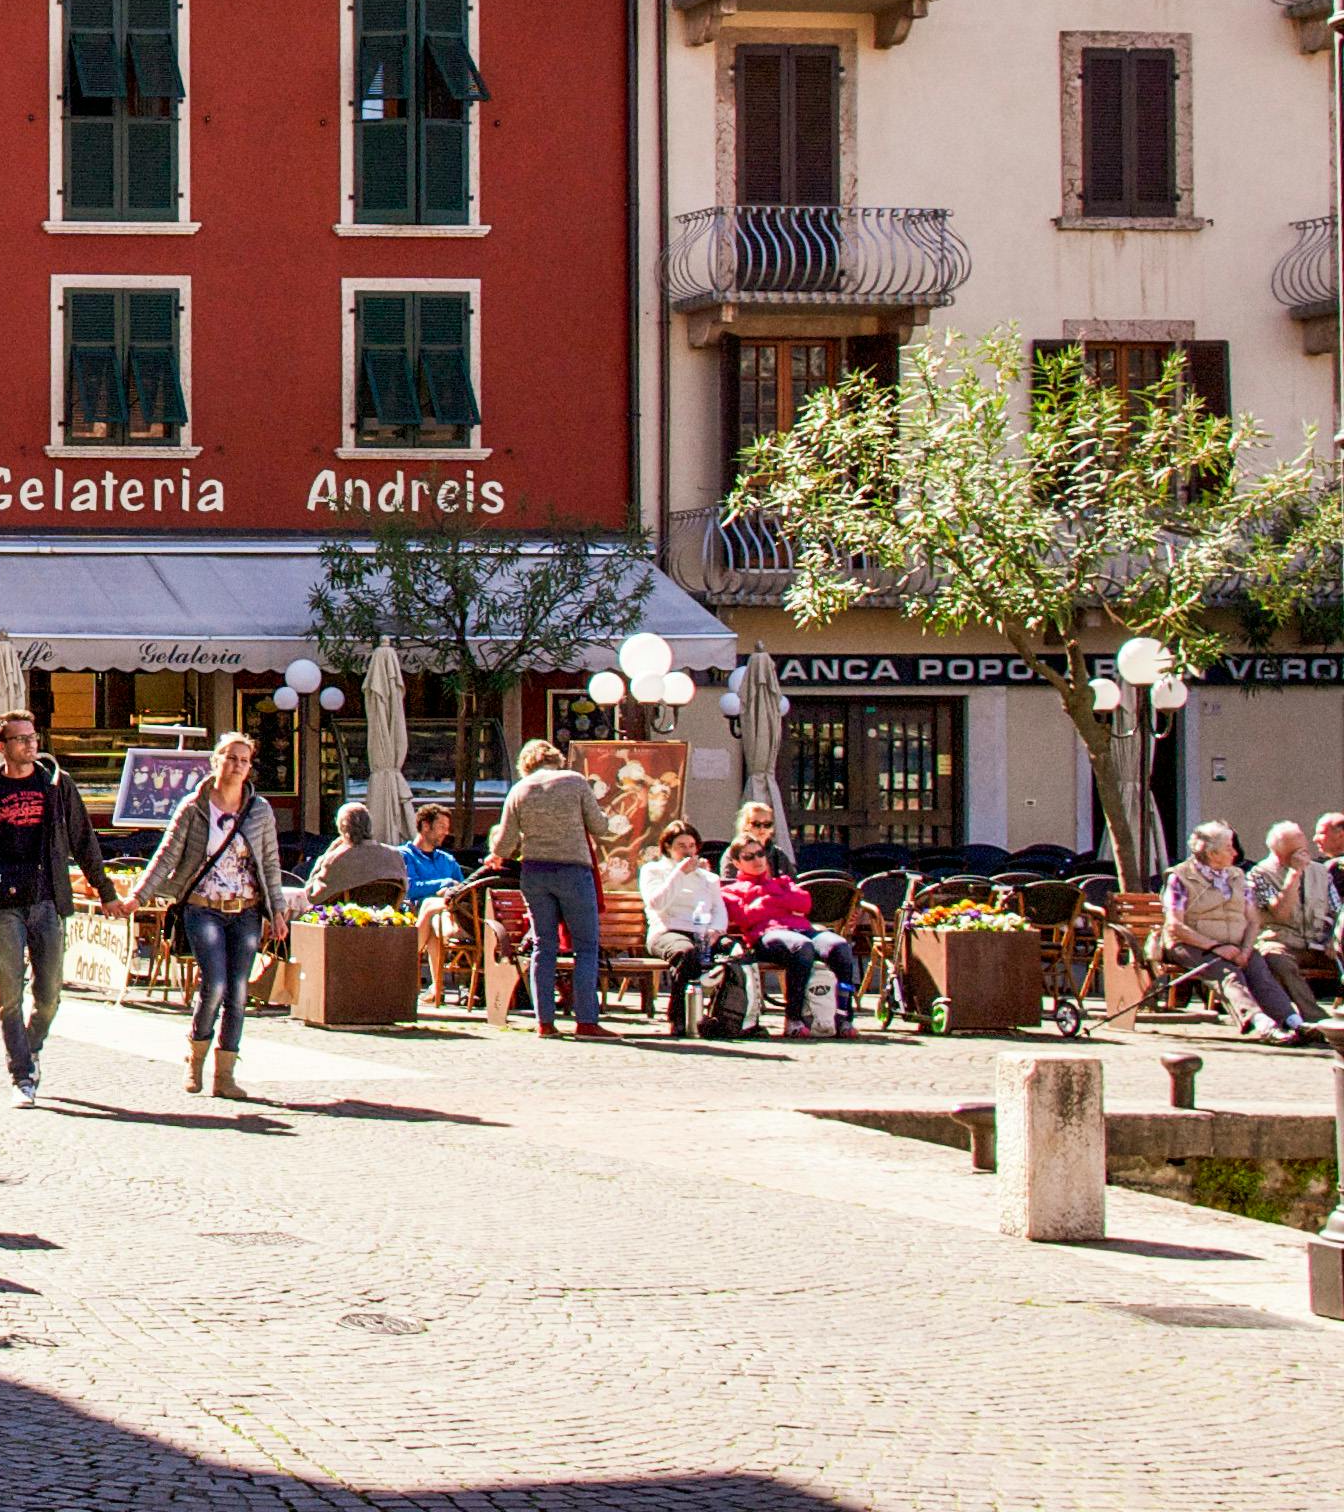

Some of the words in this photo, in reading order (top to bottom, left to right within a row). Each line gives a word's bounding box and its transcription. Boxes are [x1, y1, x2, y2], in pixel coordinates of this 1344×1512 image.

[306, 469, 505, 514] Andreis
[138, 642, 244, 666] Gelateria
[780, 658, 900, 681] ANCA
[76, 956, 112, 986] Andreis
